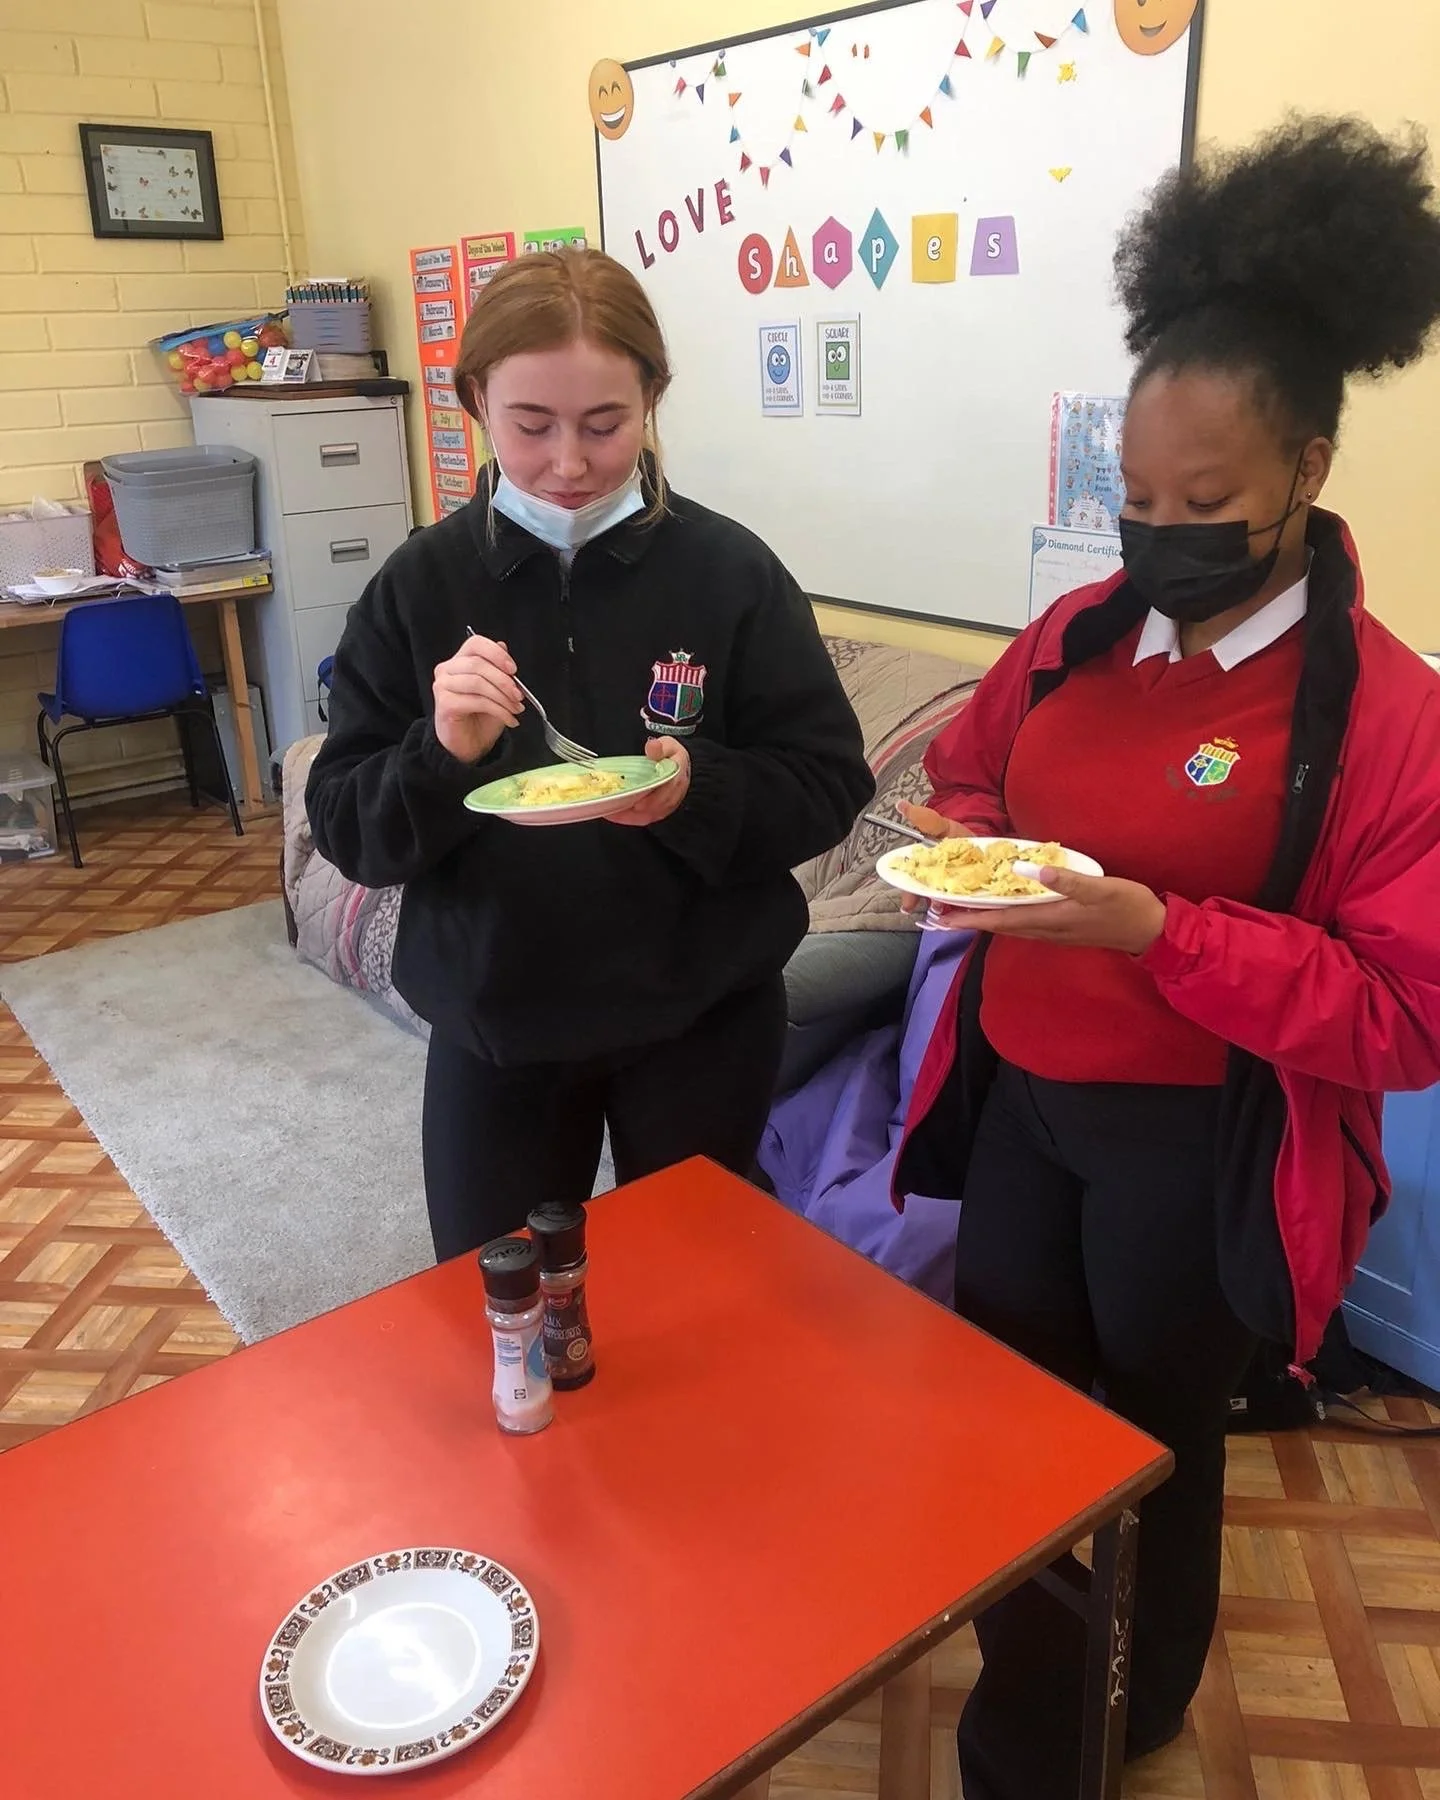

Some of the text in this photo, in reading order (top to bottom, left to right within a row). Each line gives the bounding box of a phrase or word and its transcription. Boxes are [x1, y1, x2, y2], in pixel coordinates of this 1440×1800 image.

[634, 178, 736, 269] LOVE
[767, 331, 788, 343] CIRCLE
[825, 326, 849, 339] SQUARE
[269, 355, 276, 365] 4
[1048, 538, 1085, 553] Diamond
